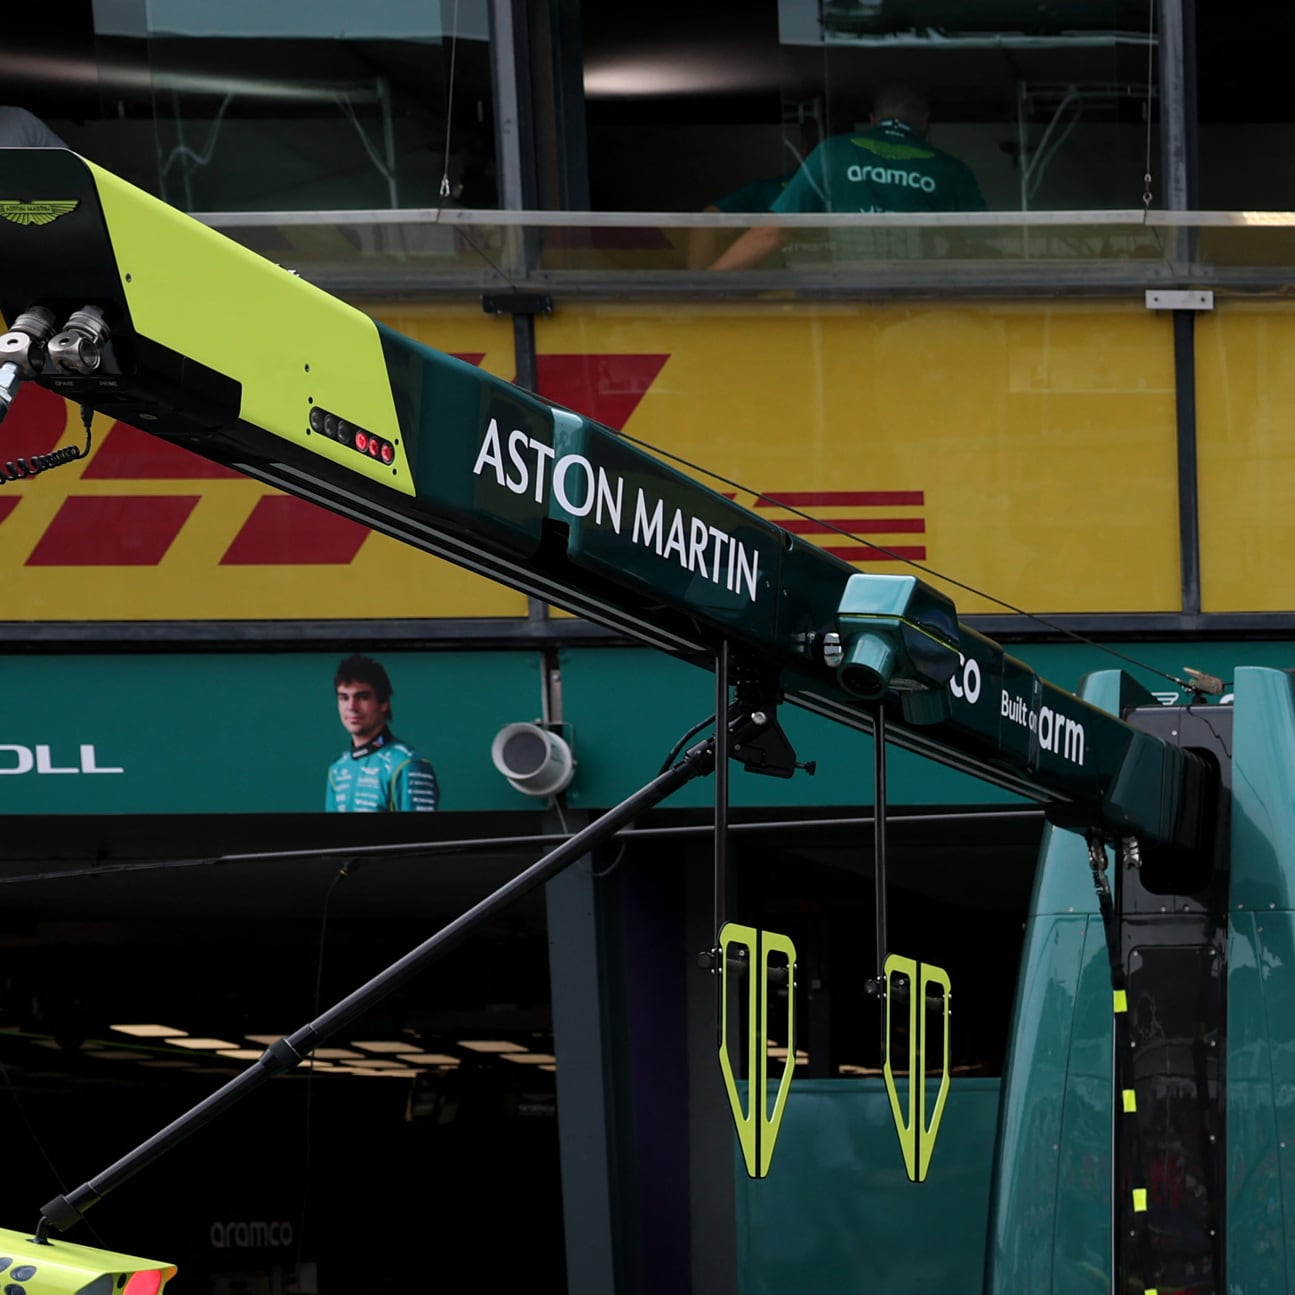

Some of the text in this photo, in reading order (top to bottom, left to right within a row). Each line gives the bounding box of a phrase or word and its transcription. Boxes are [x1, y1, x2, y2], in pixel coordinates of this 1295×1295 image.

[847, 165, 936, 193] aramco
[473, 418, 623, 535] ASTON
[632, 487, 760, 602] MARTIN
[1001, 689, 1027, 727] Built
[1039, 705, 1085, 766] arm
[210, 1219, 293, 1249] aramco
